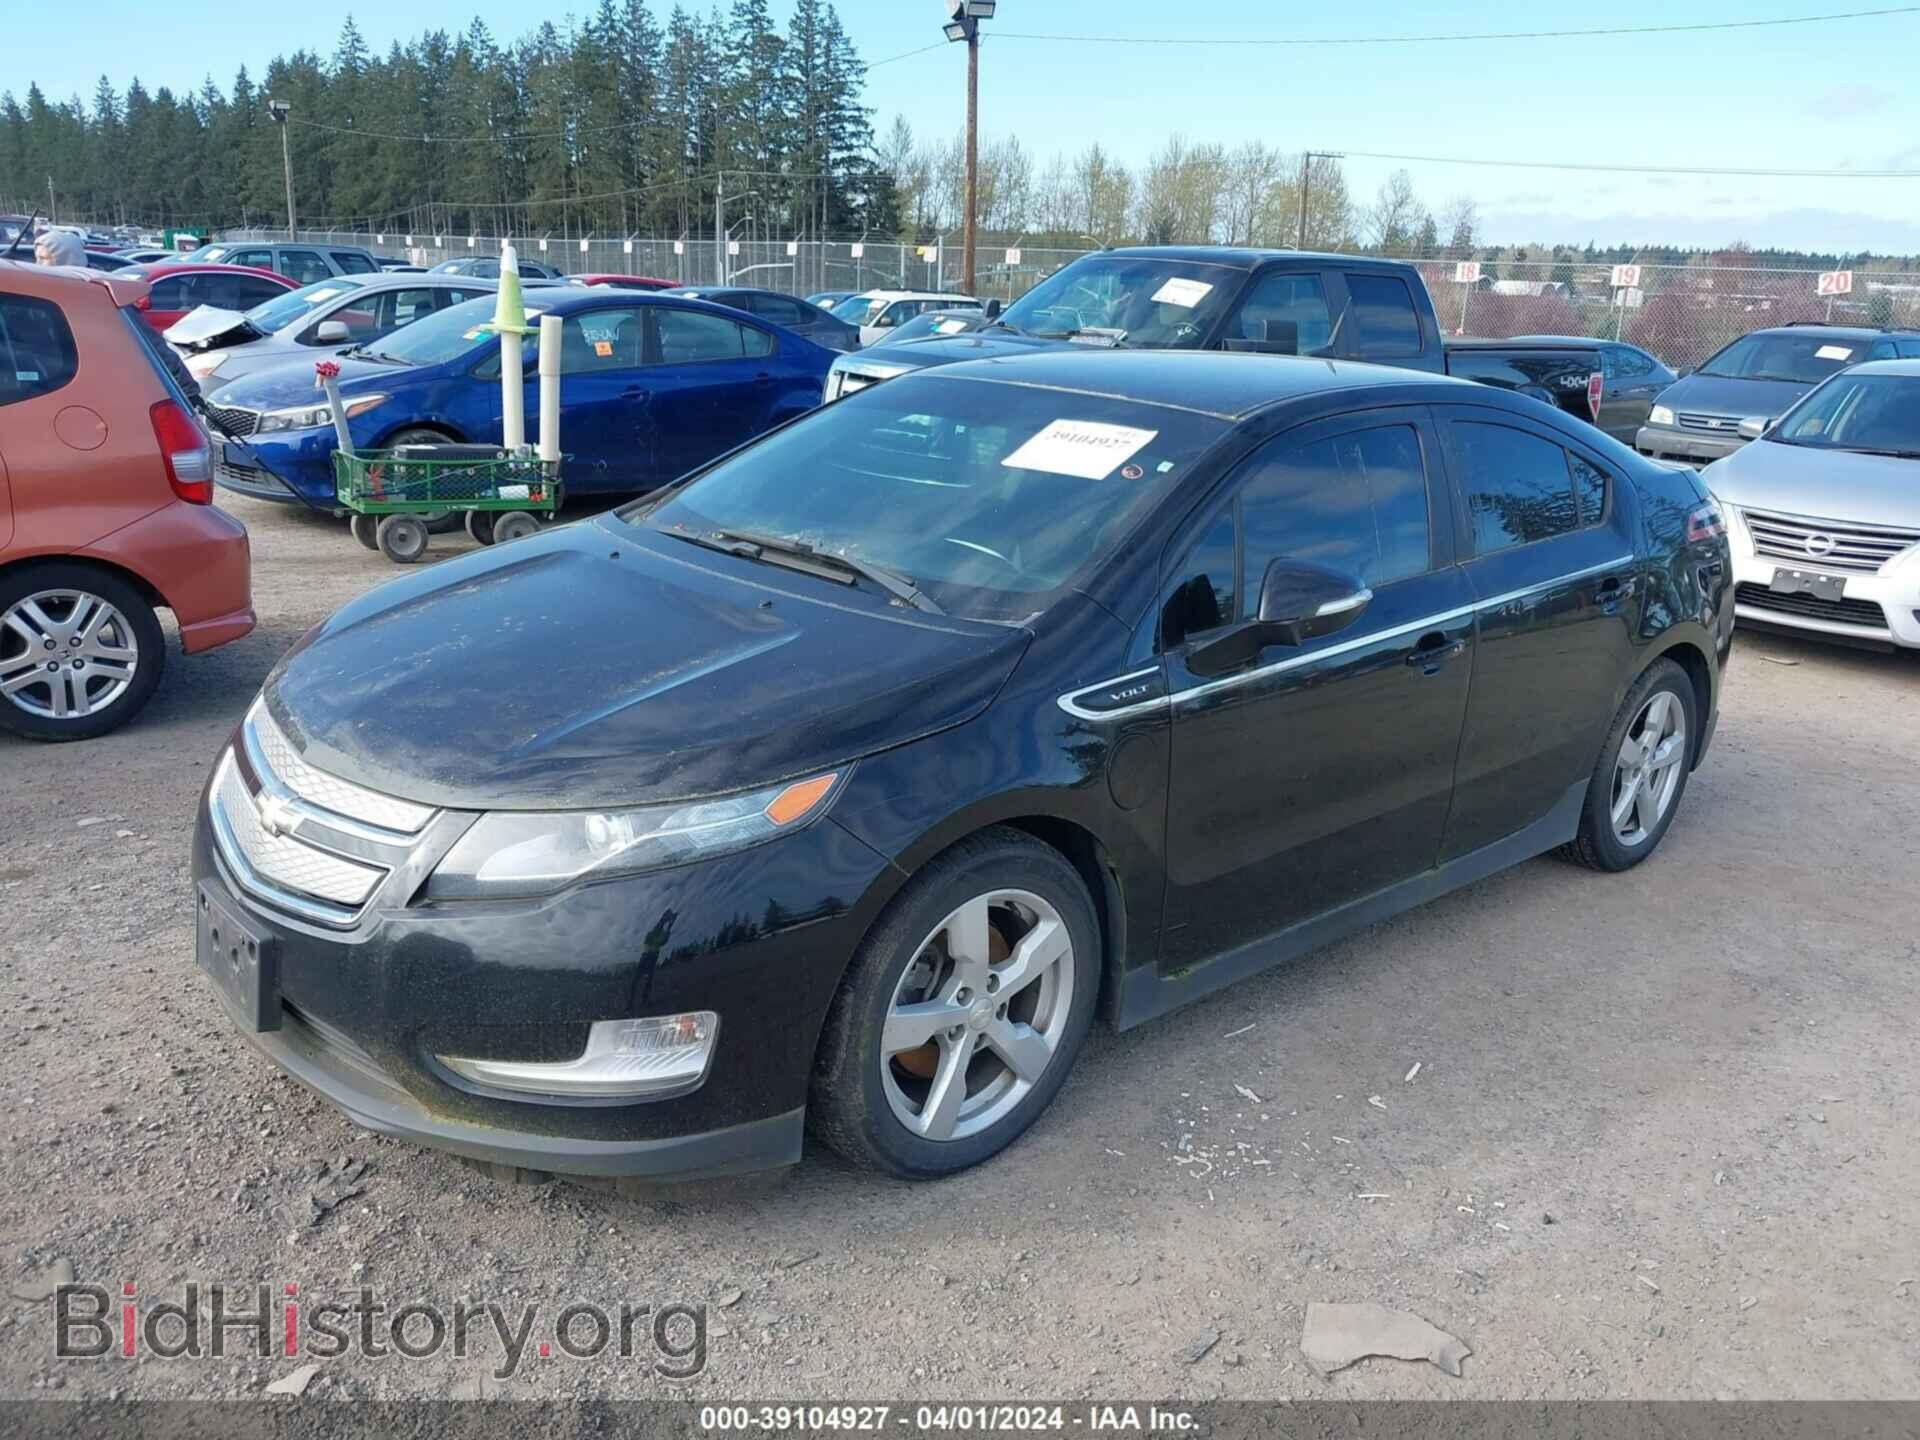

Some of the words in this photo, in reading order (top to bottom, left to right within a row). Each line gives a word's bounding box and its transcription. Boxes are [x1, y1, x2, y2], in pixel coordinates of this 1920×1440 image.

[1461, 263, 1475, 281] 18
[1617, 267, 1636, 285] 19
[1823, 272, 1849, 293] 20
[1110, 685, 1148, 700] VOLT
